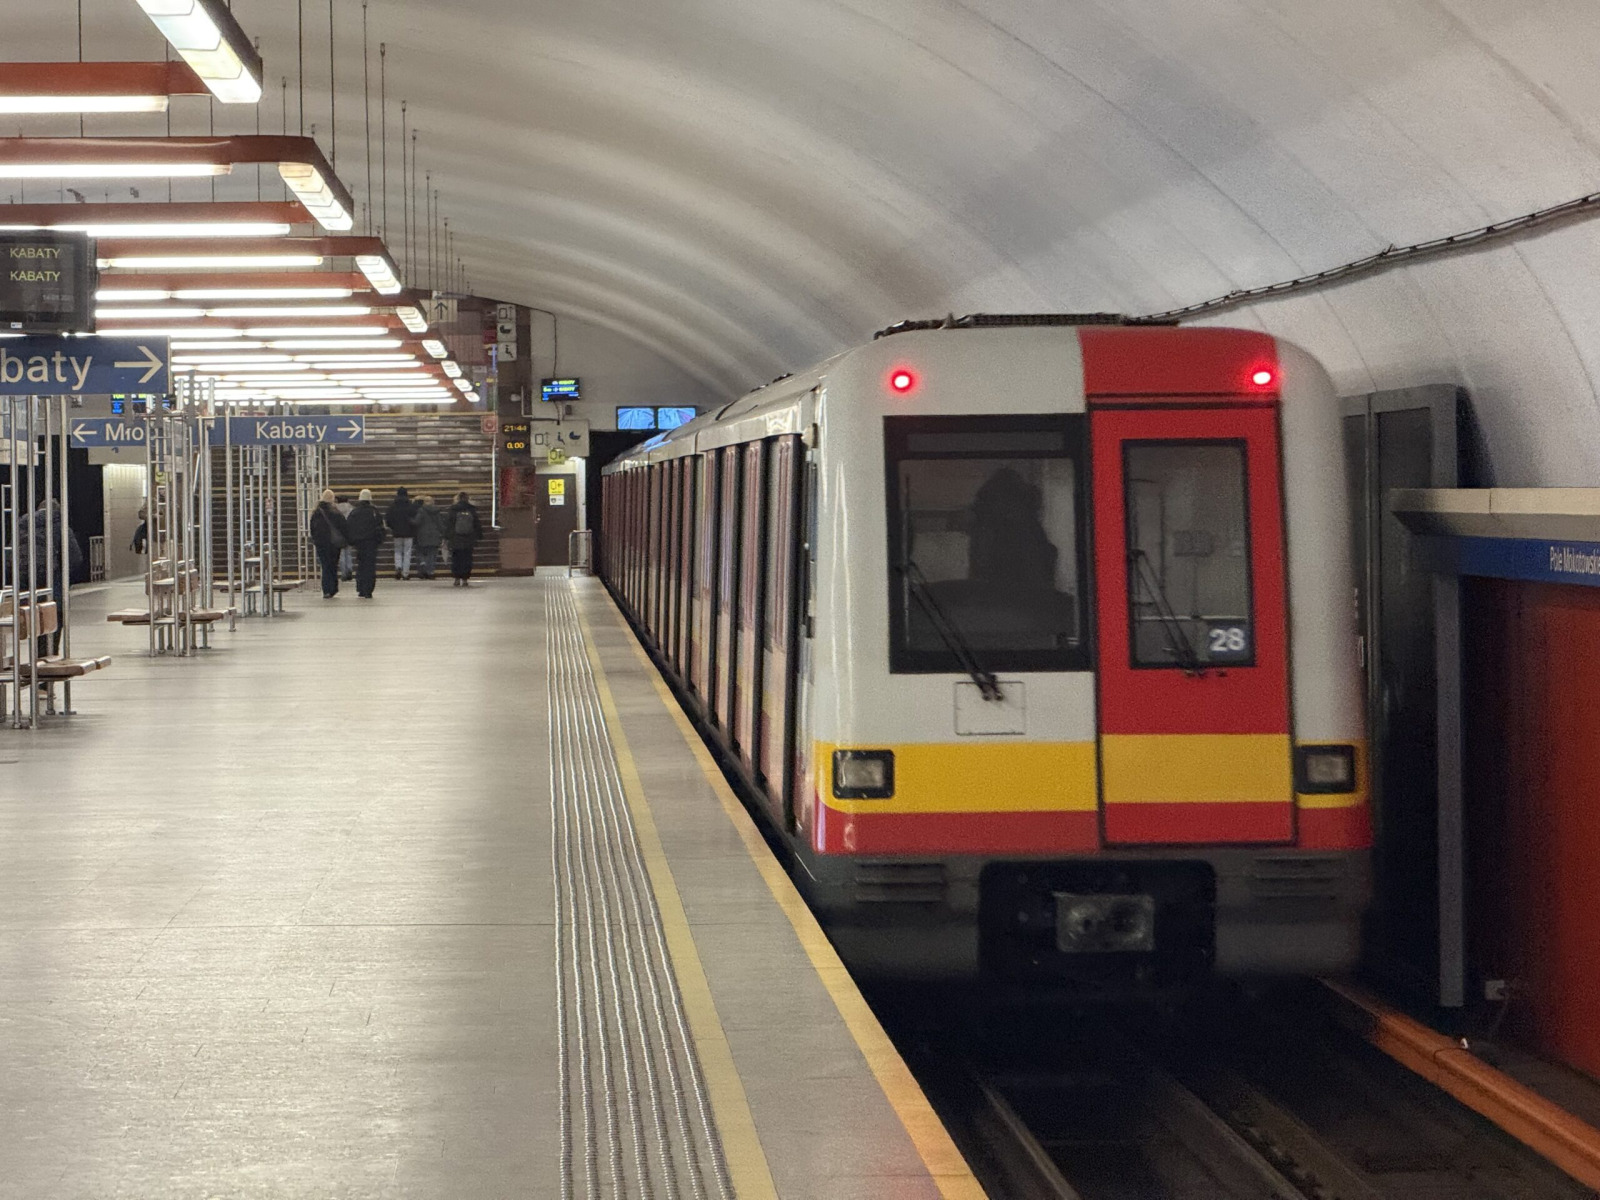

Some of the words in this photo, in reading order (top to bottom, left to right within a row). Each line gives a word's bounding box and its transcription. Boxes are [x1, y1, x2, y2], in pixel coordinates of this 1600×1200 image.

[10, 248, 60, 258] KABATY
[10, 271, 60, 281] KABATY
[256, 421, 327, 442] Kabaty
[1550, 546, 1562, 571] Pole
[1210, 628, 1244, 651] 28
